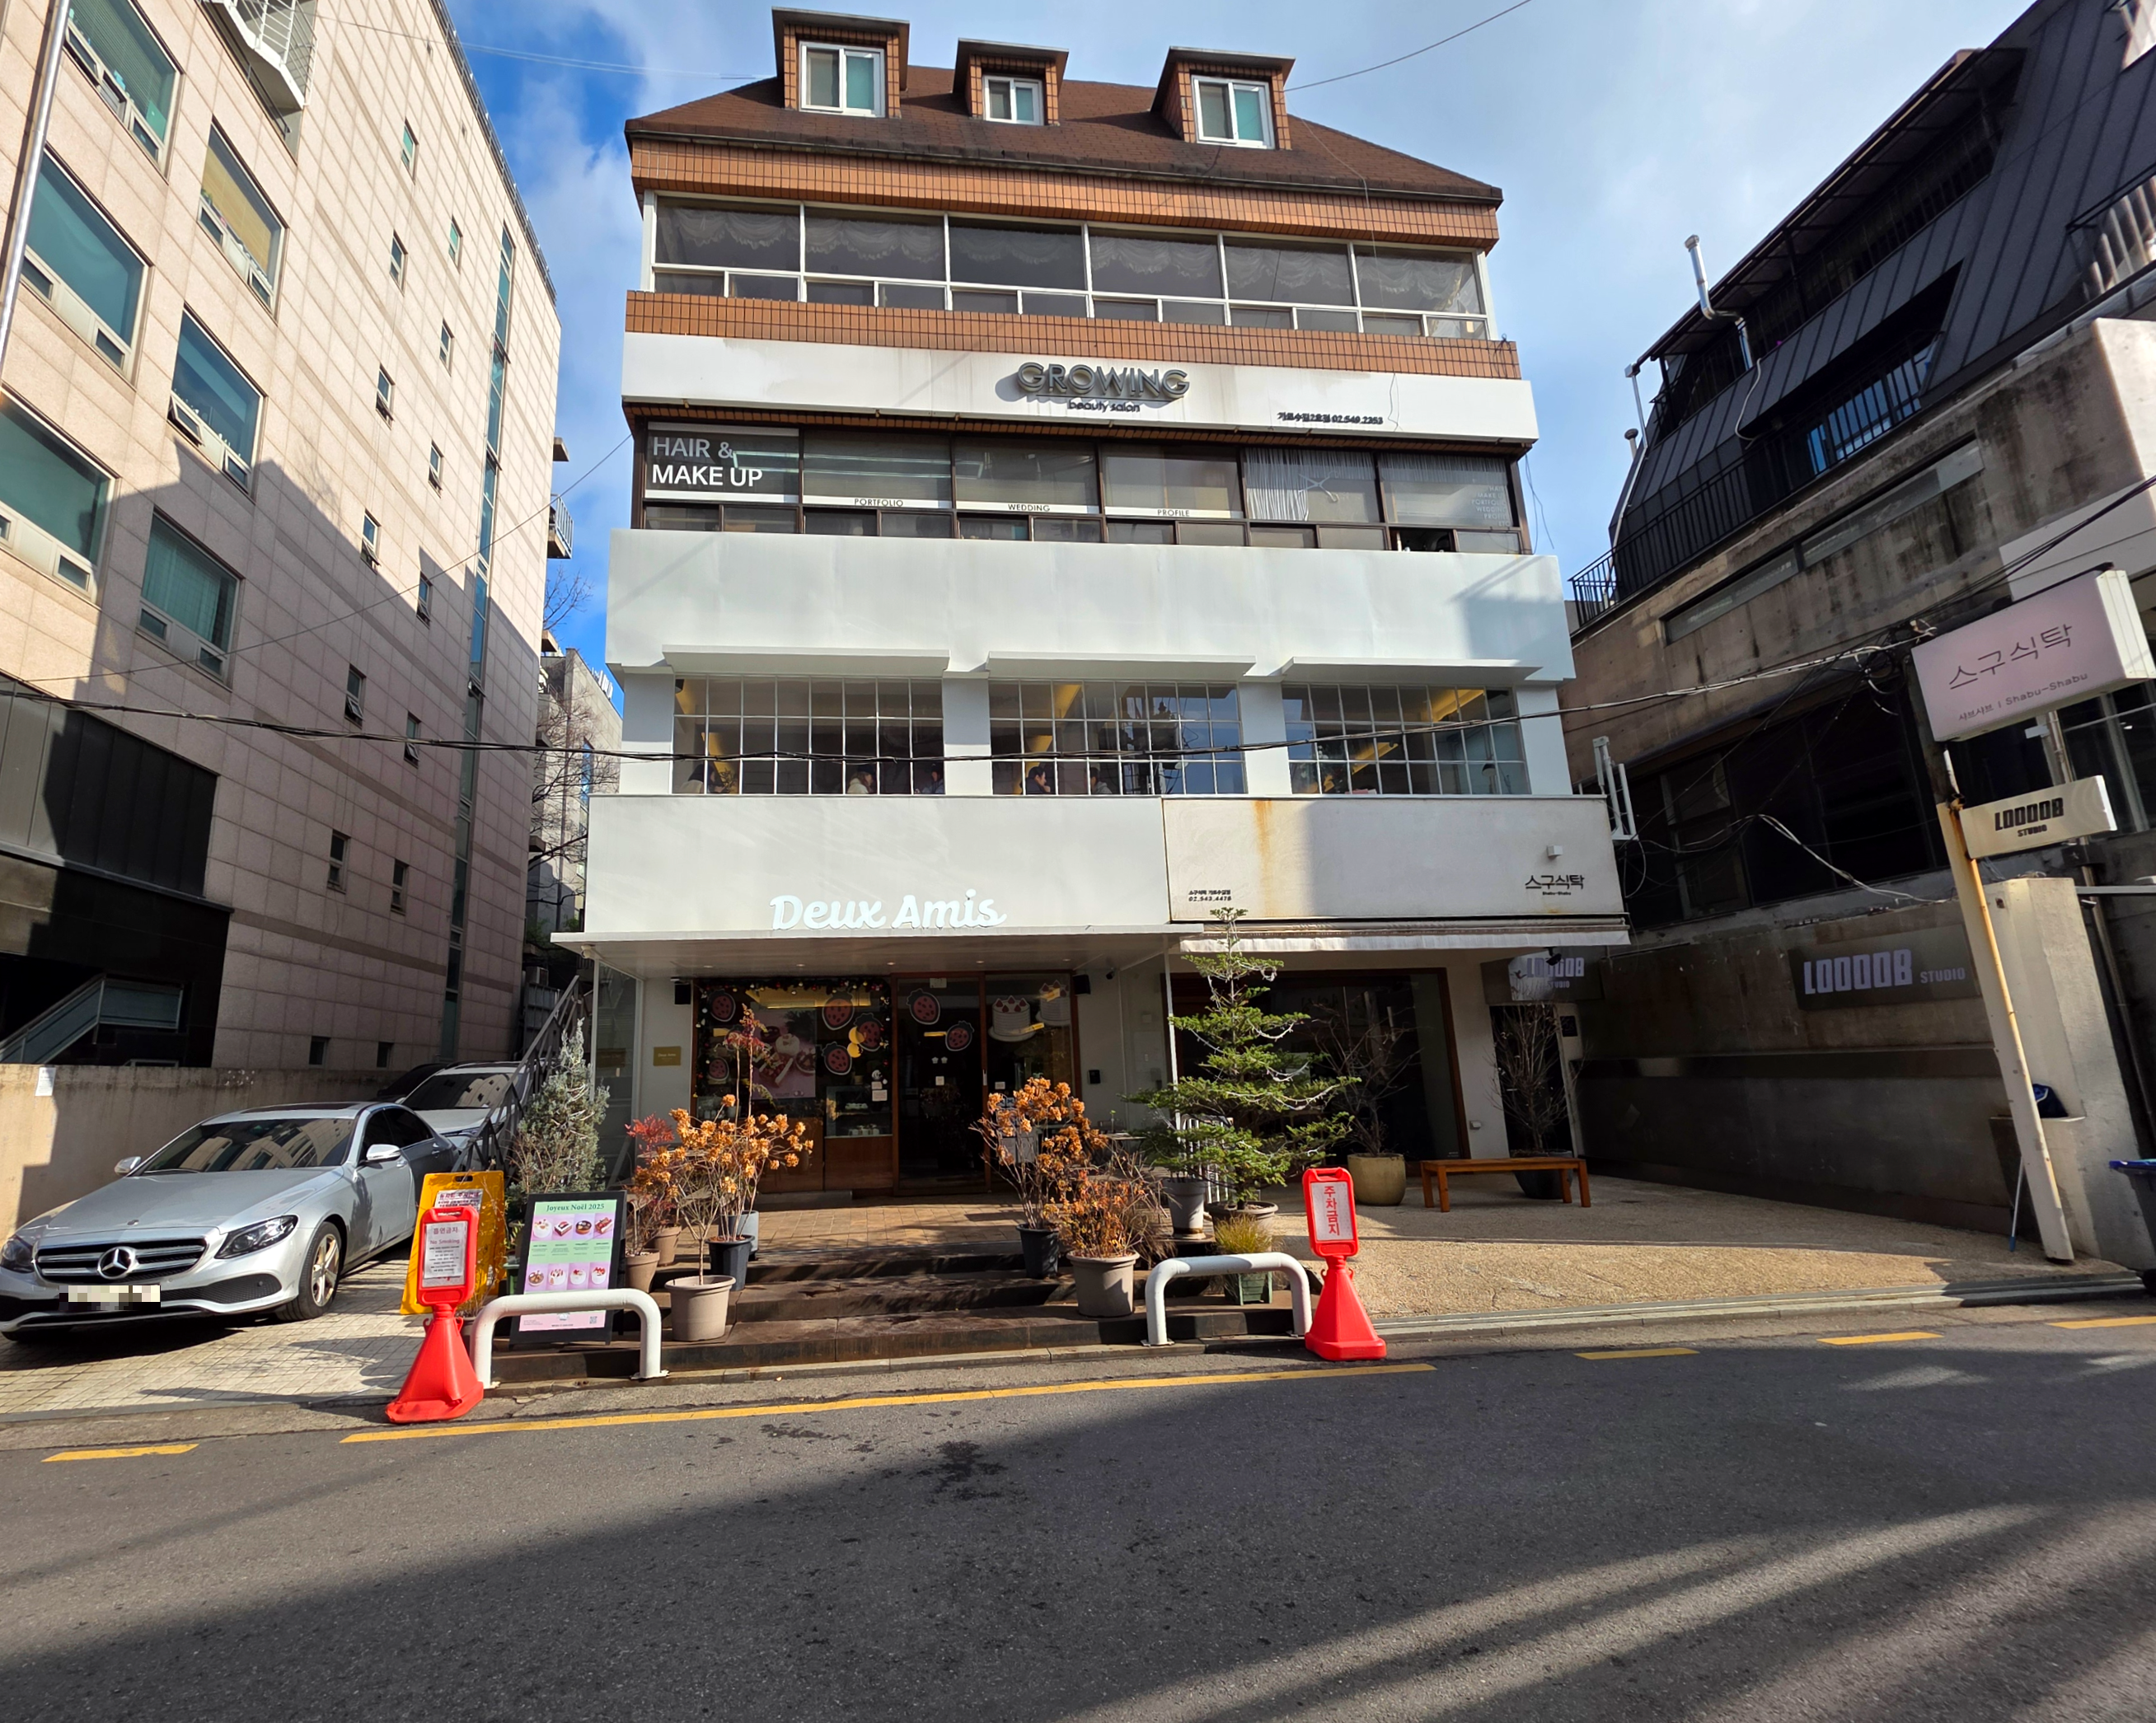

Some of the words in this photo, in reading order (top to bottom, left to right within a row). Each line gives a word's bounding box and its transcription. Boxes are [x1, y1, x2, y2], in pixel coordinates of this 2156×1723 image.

[1016, 362, 1190, 399] GROWING
[1068, 400, 1108, 414] beauty
[1110, 401, 1141, 413] salon
[653, 437, 711, 459] HAIR
[718, 441, 734, 459] &
[652, 464, 724, 486] MAKE
[730, 467, 763, 487] UP
[854, 498, 904, 508] PORTFOLIO
[1007, 503, 1051, 513] WEDDING
[1157, 508, 1191, 517] PROFILE
[1948, 623, 2073, 690] 스구식탁
[1958, 703, 1994, 722] 샤브샤브
[2005, 672, 2088, 706] Shabu-Shabu
[2018, 824, 2048, 837] STUDIO
[1525, 874, 1585, 890] 스구식탁
[770, 895, 887, 930] Deux
[891, 888, 1008, 930] Amis
[1920, 967, 1966, 985] STUDIO
[1324, 1185, 1341, 1236] 주차금지
[433, 1226, 458, 1235] 흡연금지
